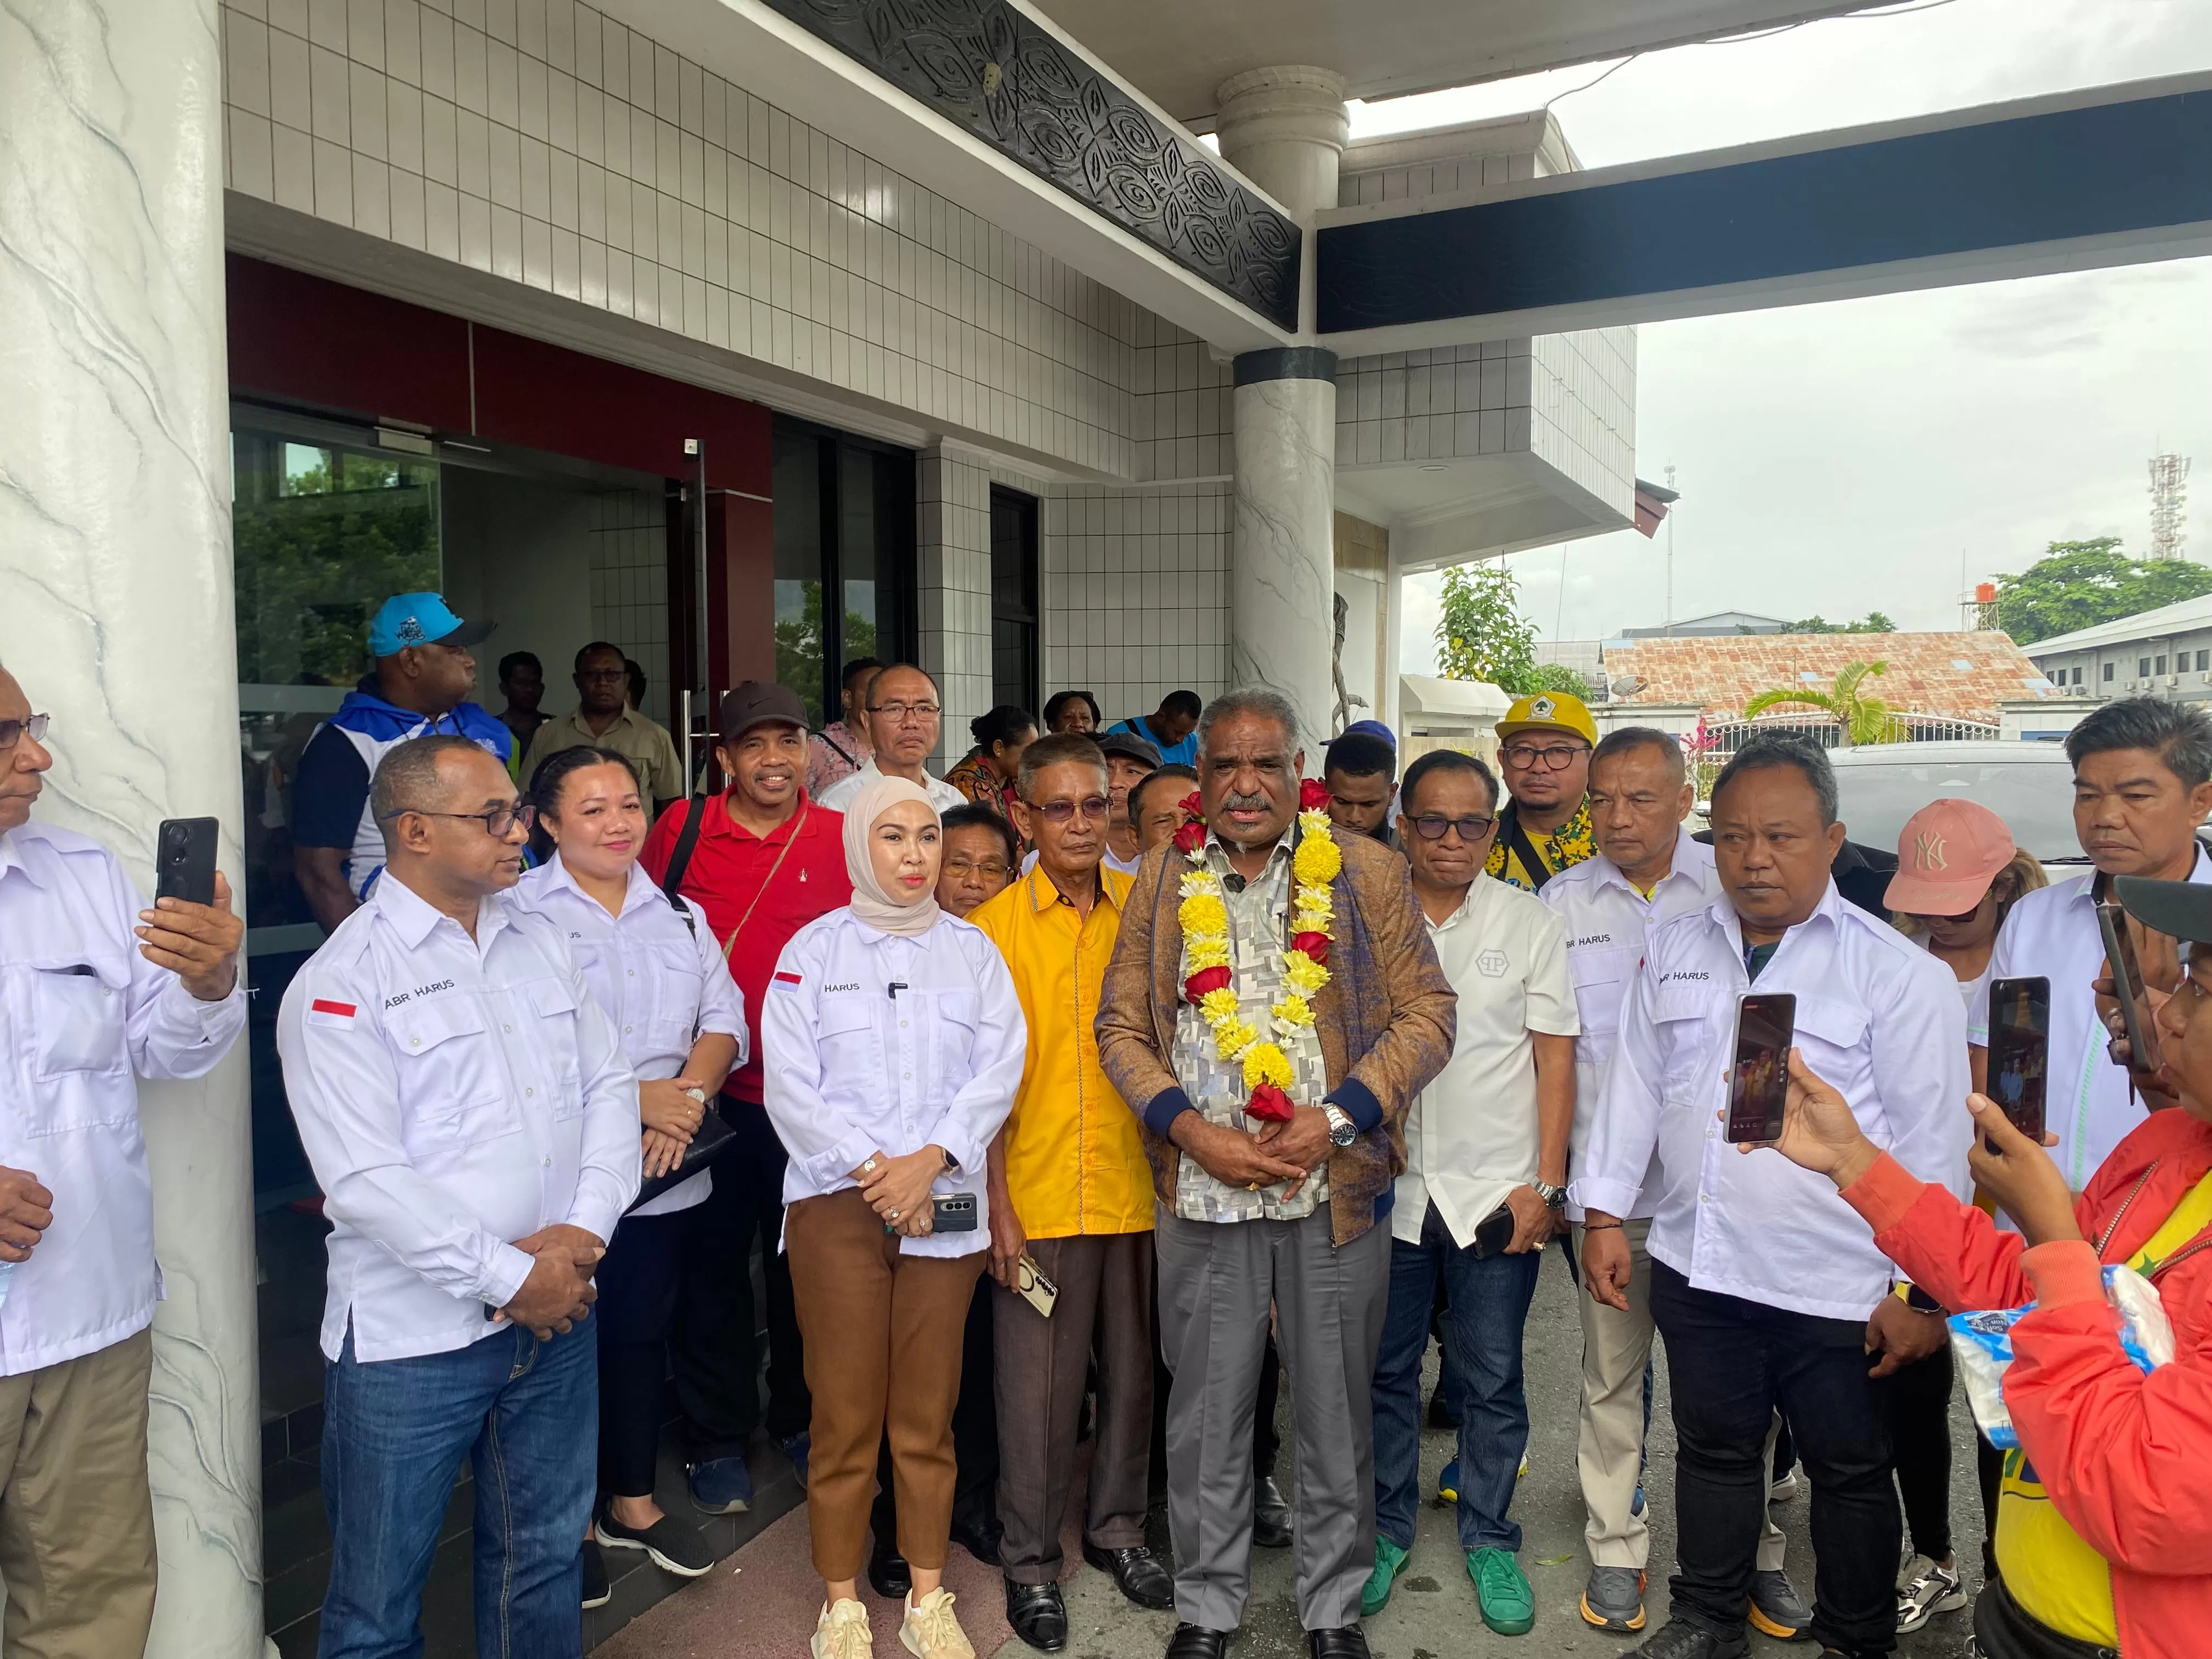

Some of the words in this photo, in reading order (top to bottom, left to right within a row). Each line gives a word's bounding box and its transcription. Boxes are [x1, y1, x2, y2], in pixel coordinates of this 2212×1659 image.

[1578, 934, 1611, 946] HARUS
[1673, 972, 1709, 980] HARUS
[825, 983, 860, 992] HARUS
[385, 993, 411, 1010] ABR
[414, 979, 455, 997] HARUS
